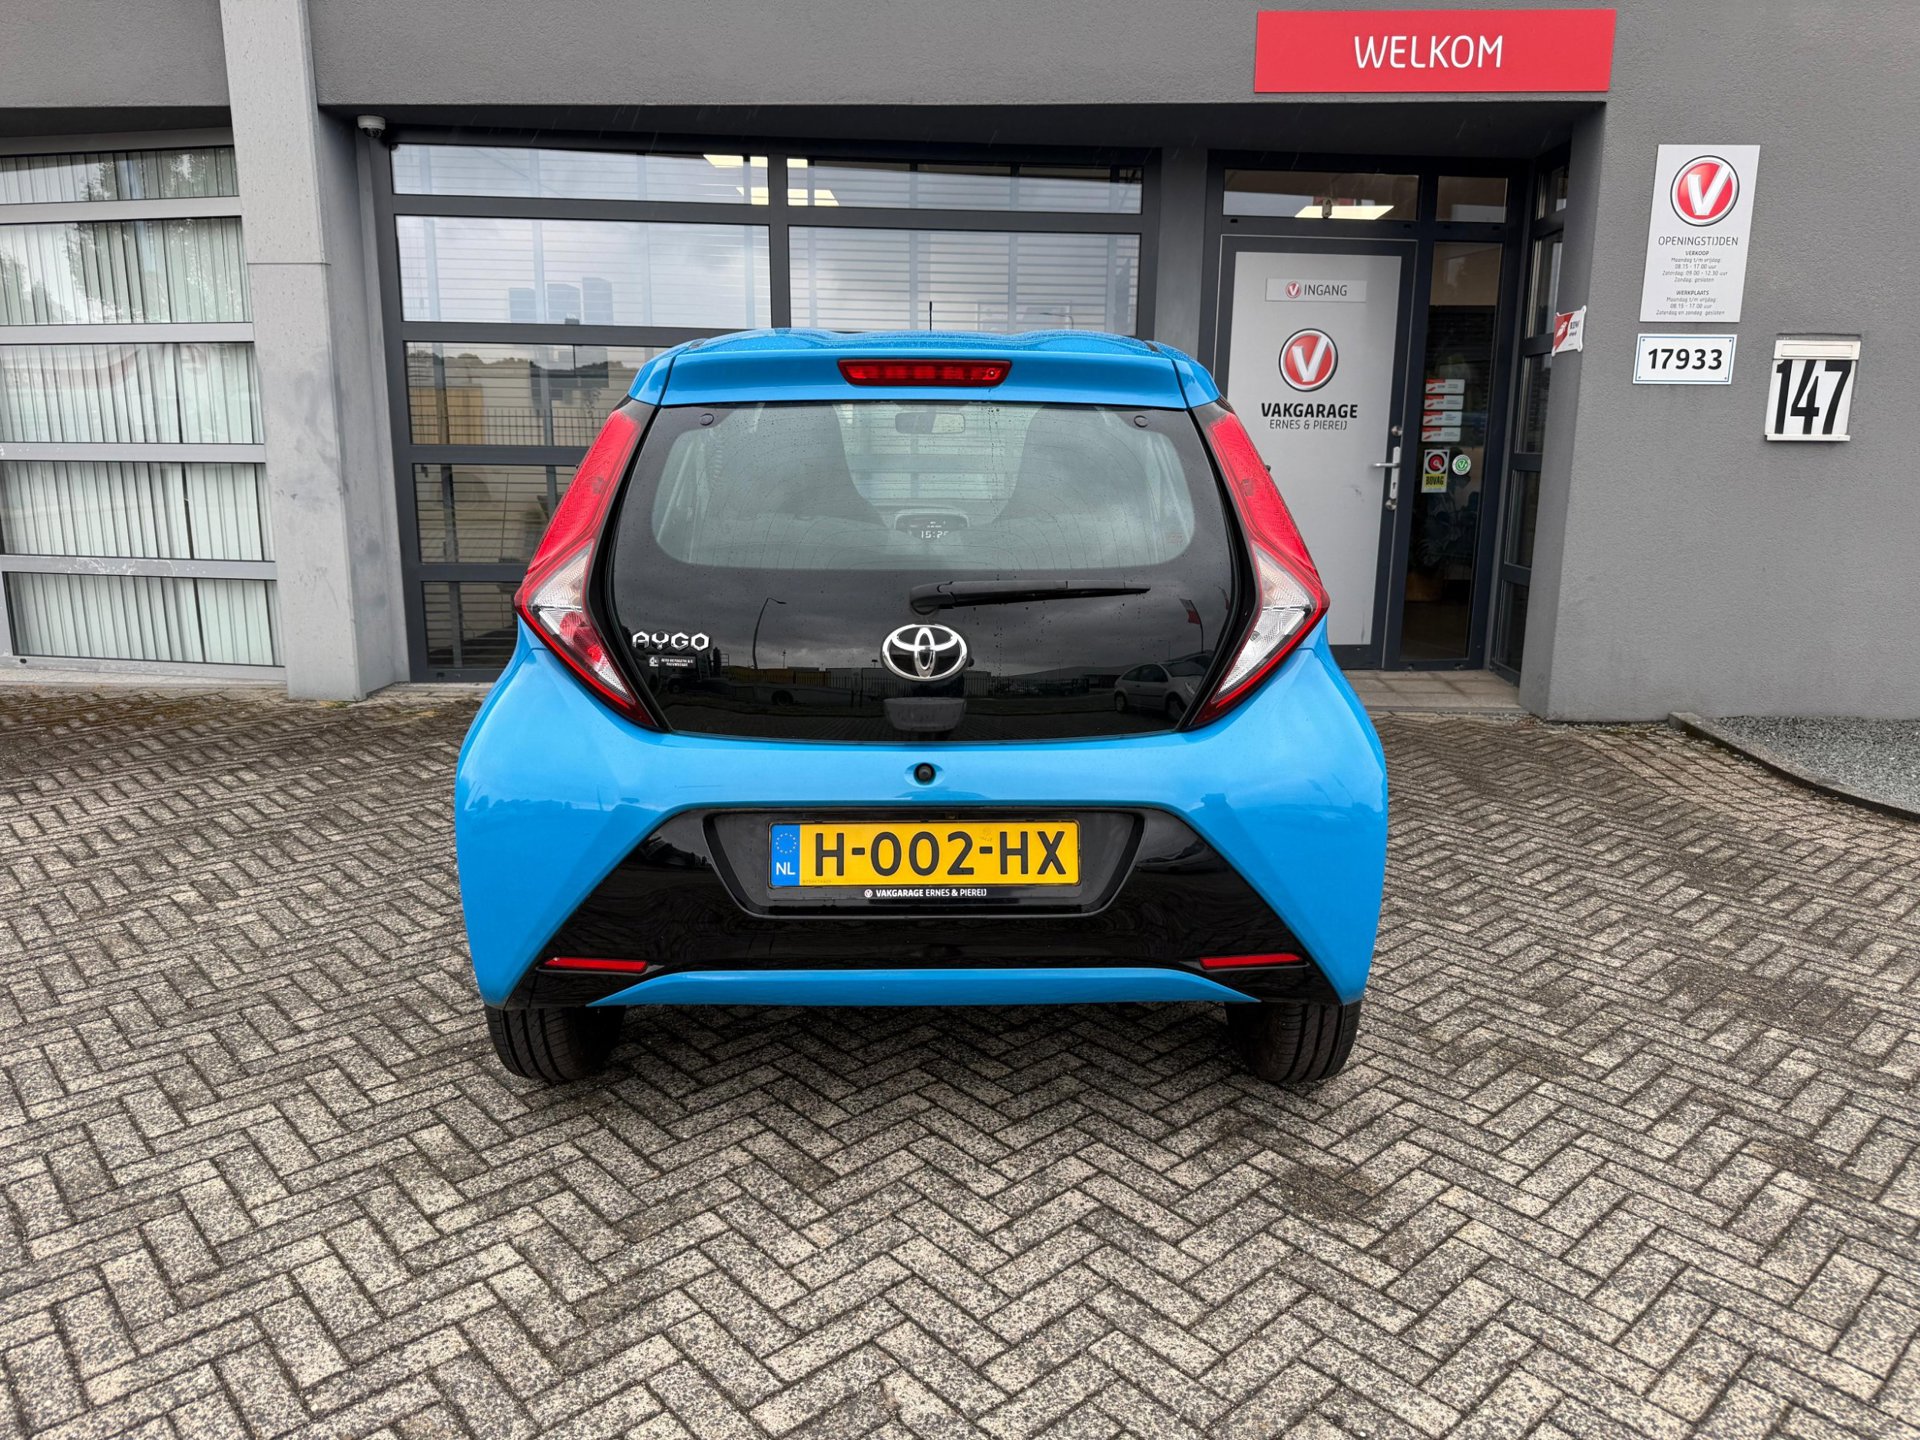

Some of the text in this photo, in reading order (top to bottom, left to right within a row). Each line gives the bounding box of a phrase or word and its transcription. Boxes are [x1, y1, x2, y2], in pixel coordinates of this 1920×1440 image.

[1354, 35, 1503, 68] WELKOM
[1687, 162, 1731, 216] V
[1658, 236, 1739, 246] OPENINGSTIJDEN
[1304, 284, 1348, 296] INGANG
[1292, 333, 1329, 382] V
[1648, 348, 1723, 370] 17933
[1774, 359, 1852, 435] 147
[1261, 403, 1358, 418] VAKGARAGE
[1269, 419, 1348, 430] ERNES & PIEREIJ
[1425, 476, 1444, 485] BOVAG
[632, 631, 710, 651] AYGO
[815, 831, 1067, 876] H-002-HX
[776, 862, 795, 875] NL
[876, 889, 923, 897] VAKGARAGE
[925, 889, 950, 897] ERNES
[951, 889, 958, 897] &
[960, 888, 987, 896] PIEREIJ
